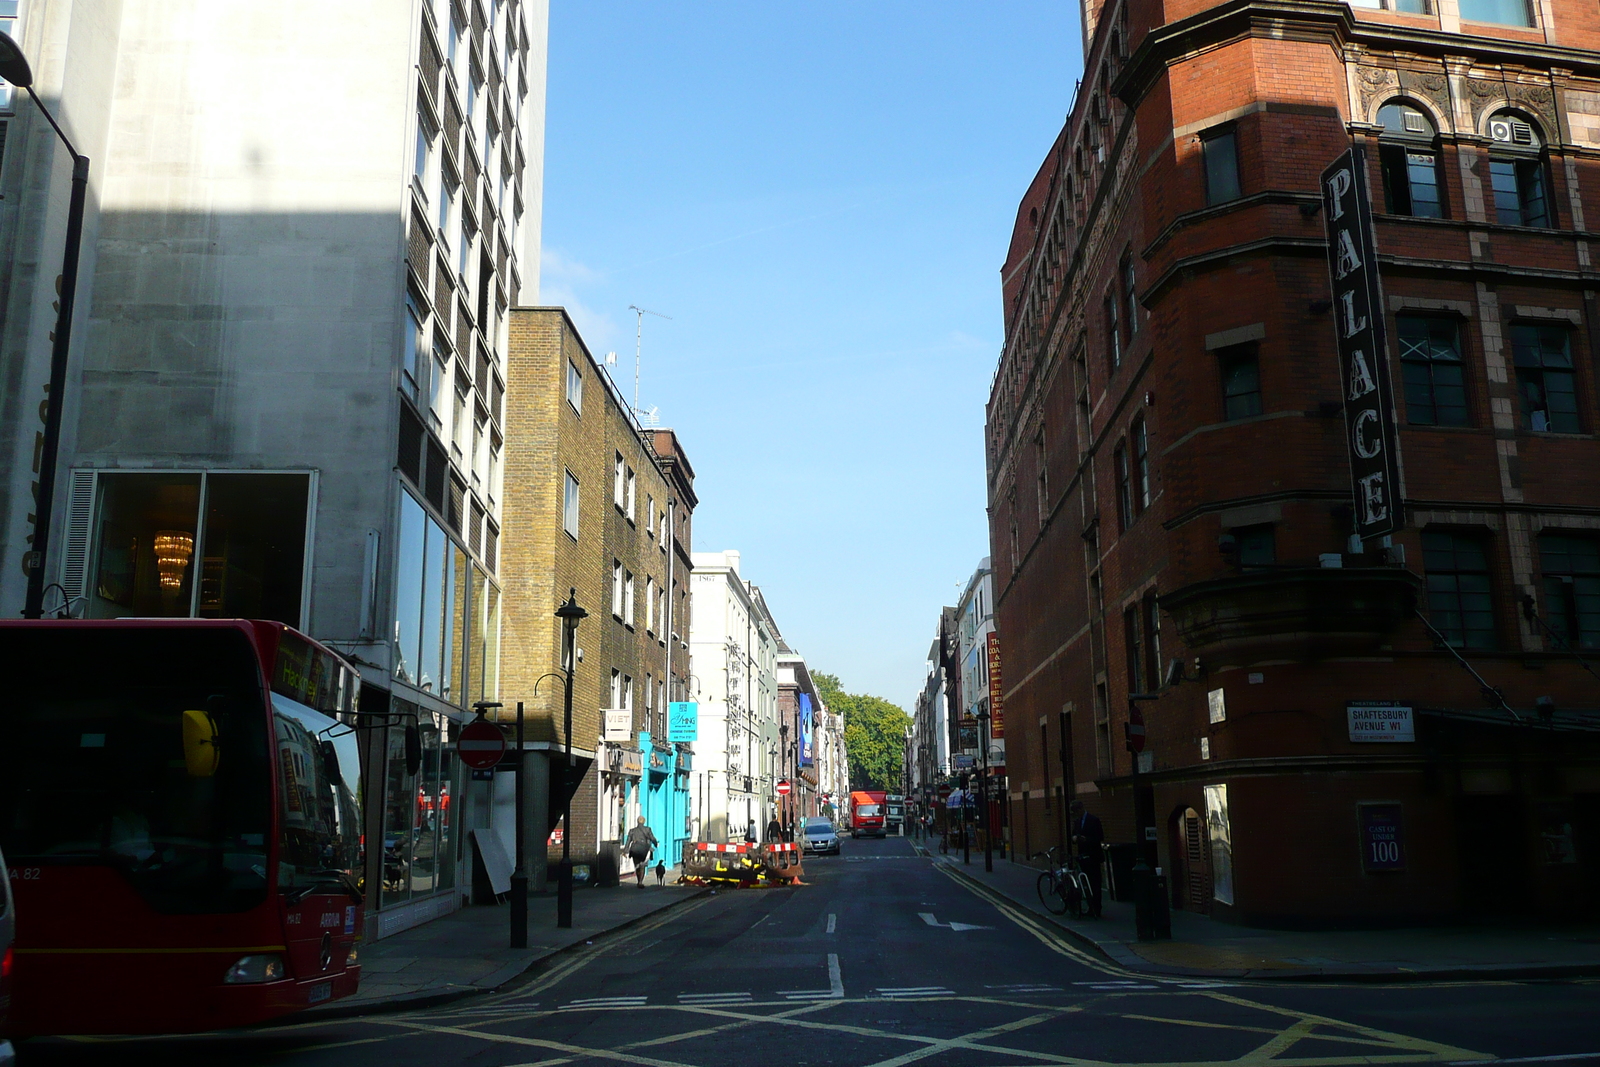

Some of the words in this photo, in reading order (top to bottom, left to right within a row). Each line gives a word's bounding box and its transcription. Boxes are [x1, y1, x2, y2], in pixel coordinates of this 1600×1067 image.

[1326, 167, 1389, 526] PALACE
[607, 715, 630, 723] VIET
[1352, 710, 1408, 720] SHAFTESBURY
[1354, 721, 1386, 731] AVENUE
[1389, 721, 1401, 731] W1
[1369, 825, 1386, 833] CAST
[1387, 825, 1397, 833] OF
[1372, 833, 1396, 841] UNDER
[1371, 841, 1399, 863] 100
[23, 867, 41, 880] 82
[320, 912, 341, 928] ARRIVA
